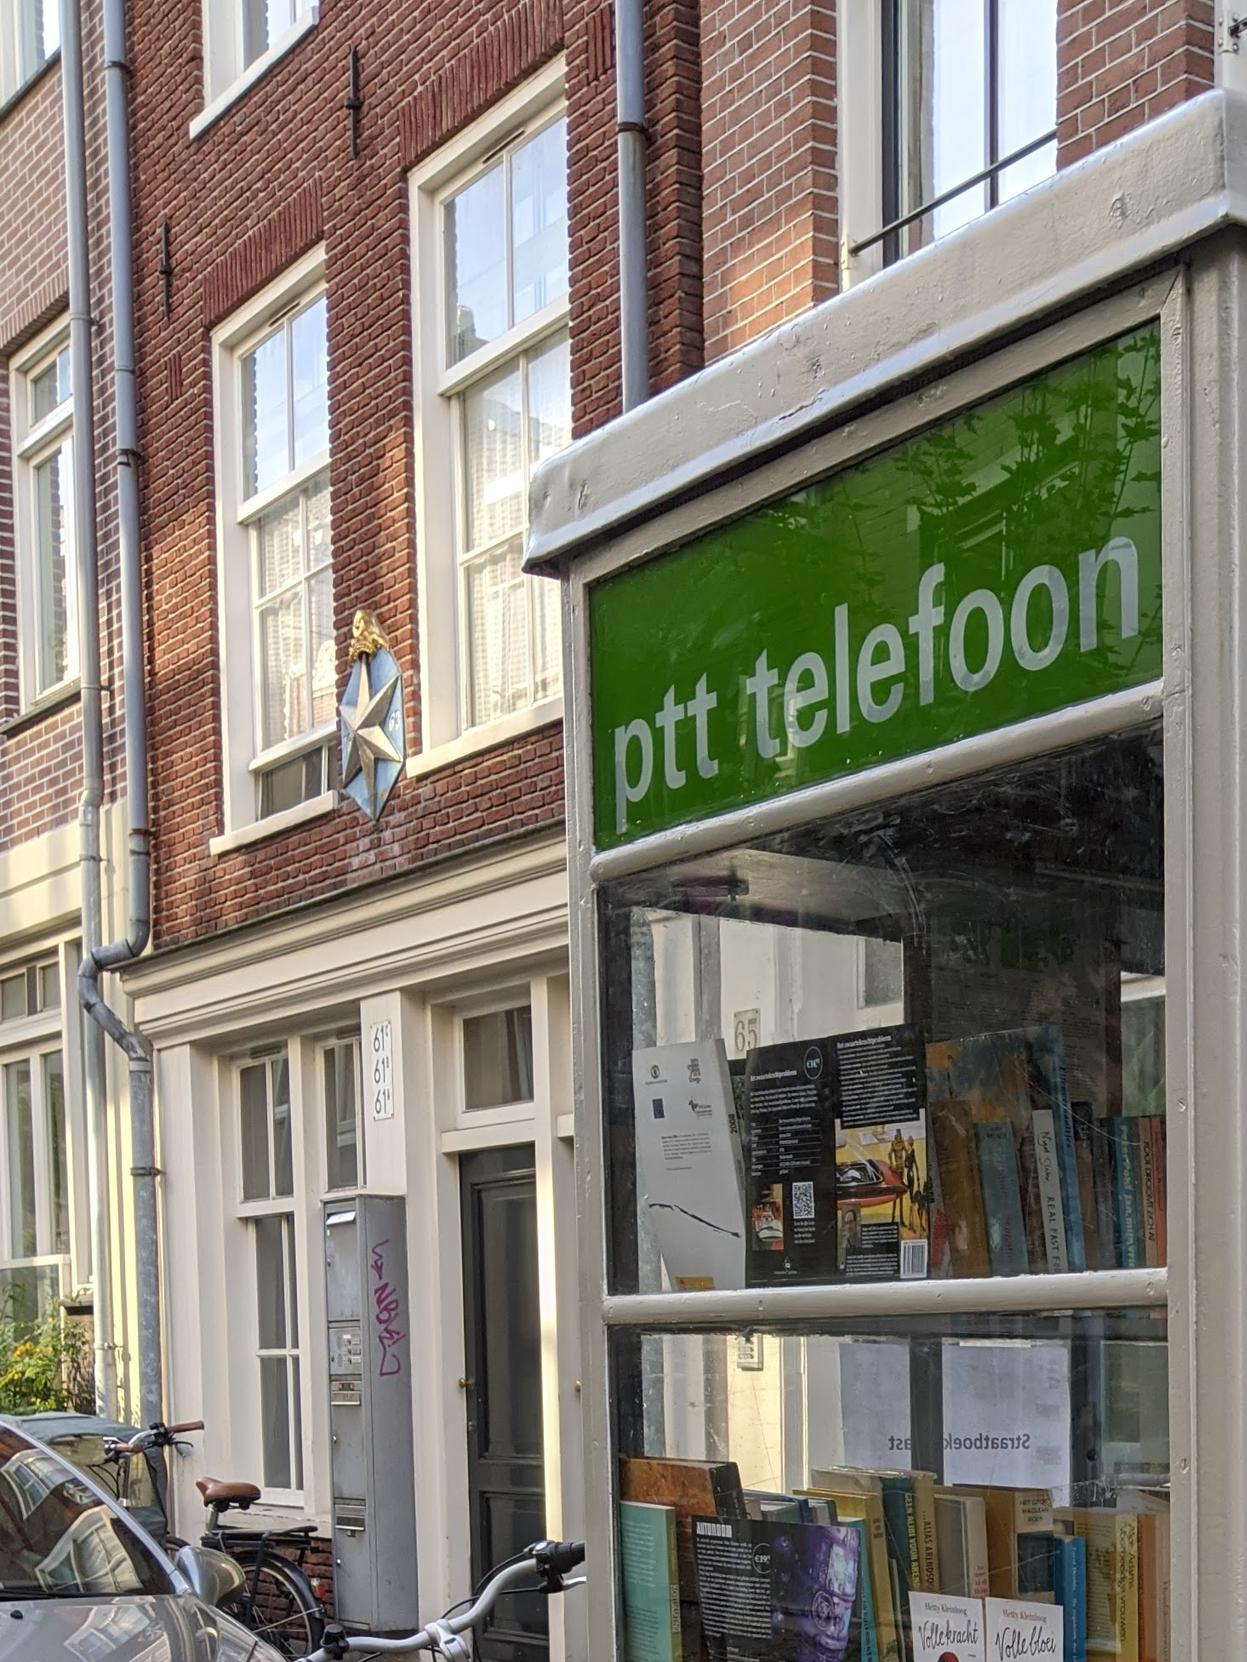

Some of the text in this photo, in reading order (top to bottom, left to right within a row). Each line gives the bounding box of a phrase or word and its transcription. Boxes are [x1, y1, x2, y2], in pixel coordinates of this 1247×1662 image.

[614, 535, 1140, 834] ptt telefoon
[1002, 1608, 1019, 1622] Hetty
[918, 1619, 979, 1651] Volle kracht
[995, 1625, 1057, 1662] Volle bloei
